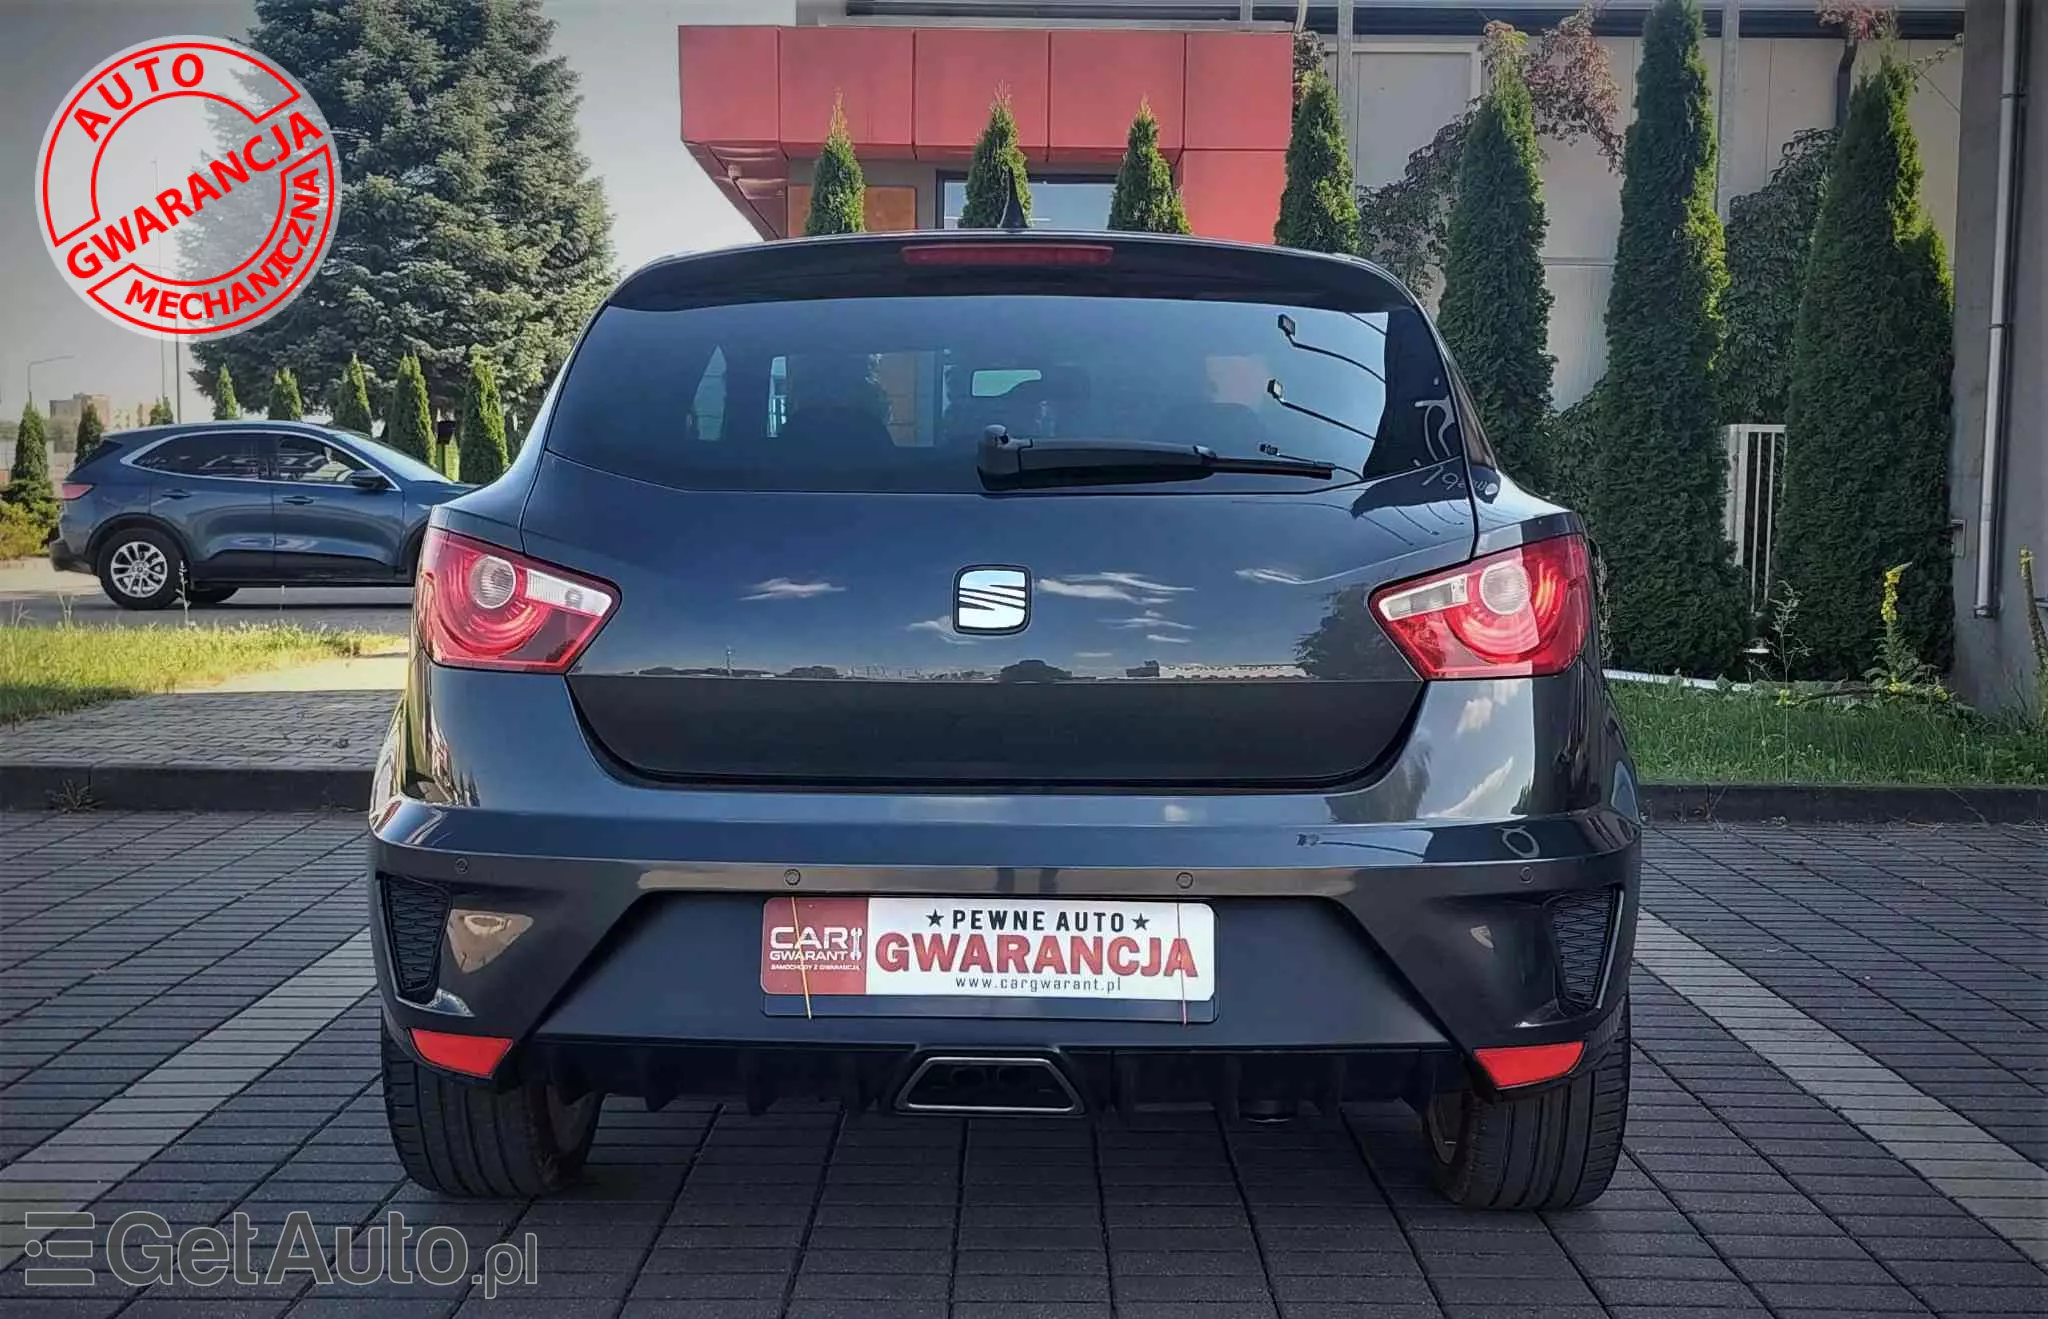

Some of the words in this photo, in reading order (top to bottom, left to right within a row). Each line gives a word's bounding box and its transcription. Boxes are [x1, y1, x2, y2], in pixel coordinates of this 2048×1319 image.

[952, 909, 1045, 932] PEWNE
[1056, 911, 1125, 932] AUTO
[770, 926, 848, 950] CAR
[769, 950, 848, 961] GWARANT
[874, 932, 1199, 978] GWARANCJA
[955, 976, 1121, 993] www.cargwarant.pl
